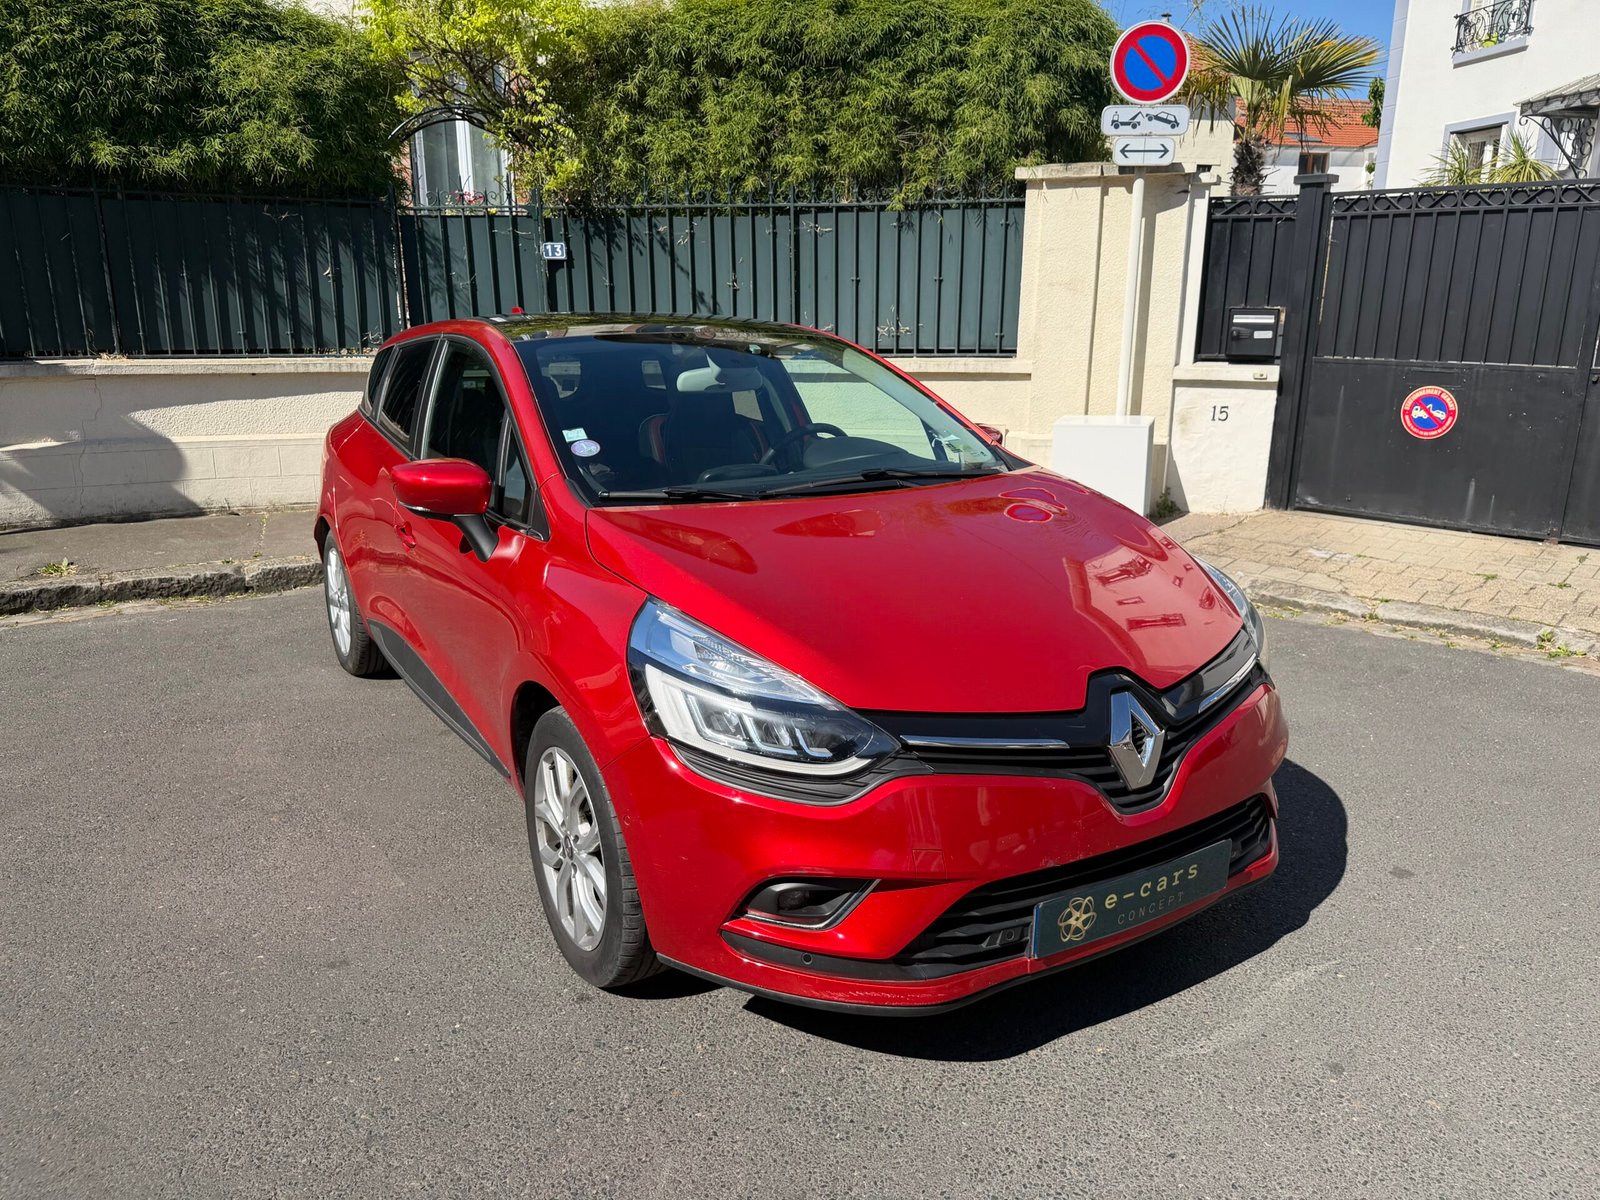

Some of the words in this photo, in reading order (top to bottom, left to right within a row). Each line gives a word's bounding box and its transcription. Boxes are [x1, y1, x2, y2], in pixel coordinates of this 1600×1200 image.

[546, 244, 562, 257] 13
[1210, 405, 1229, 422] 15
[1104, 863, 1199, 910] e-cars
[1117, 890, 1185, 926] CONCEPT
